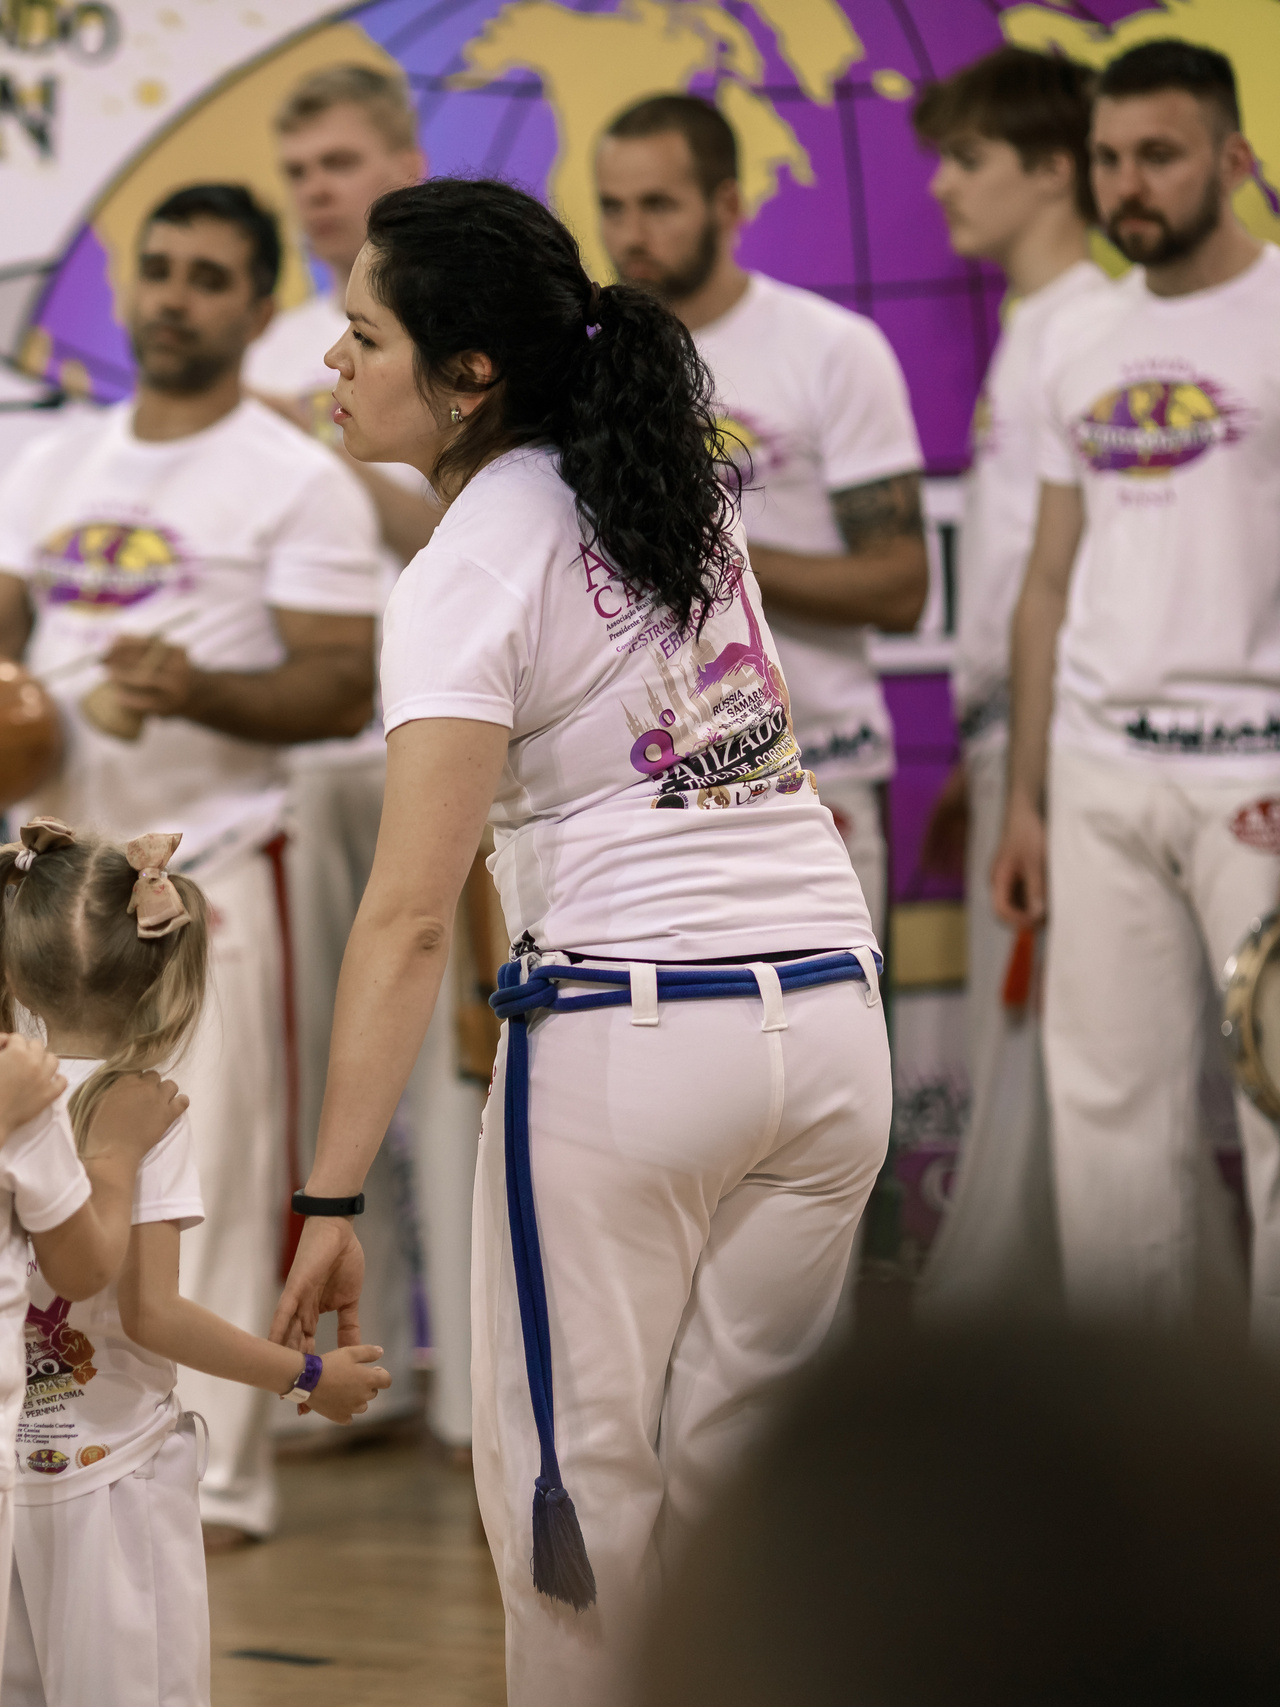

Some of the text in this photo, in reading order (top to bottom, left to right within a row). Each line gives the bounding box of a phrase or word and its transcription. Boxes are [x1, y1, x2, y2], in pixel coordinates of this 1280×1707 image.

[608, 618, 641, 642] Presidente
[727, 687, 765, 718] SAMARA
[25, 1378, 67, 1398] RDAS
[36, 1388, 84, 1405] FANTASMA
[25, 1403, 66, 1418] PERNINHA
